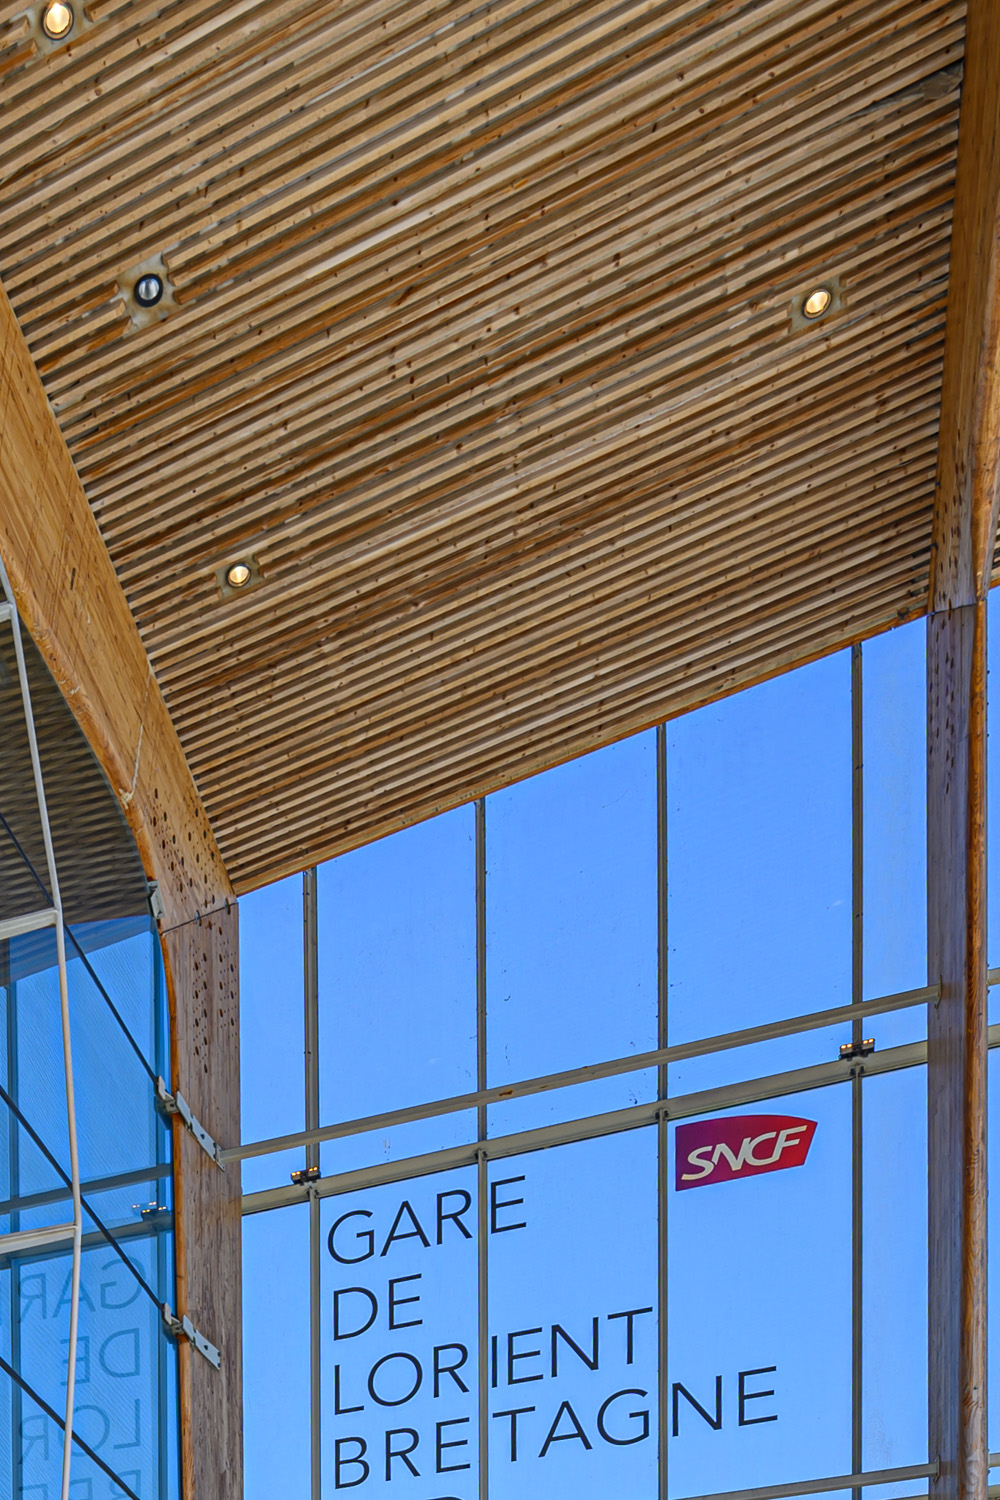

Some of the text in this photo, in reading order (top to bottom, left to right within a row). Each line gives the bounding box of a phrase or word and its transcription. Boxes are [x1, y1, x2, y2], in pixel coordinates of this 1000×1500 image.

[680, 1124, 808, 1181] SNCF
[327, 1175, 527, 1265] GARE
[333, 1274, 423, 1341] DE
[333, 1306, 653, 1416] LORIENT
[333, 1366, 779, 1490] BRETAGNE
